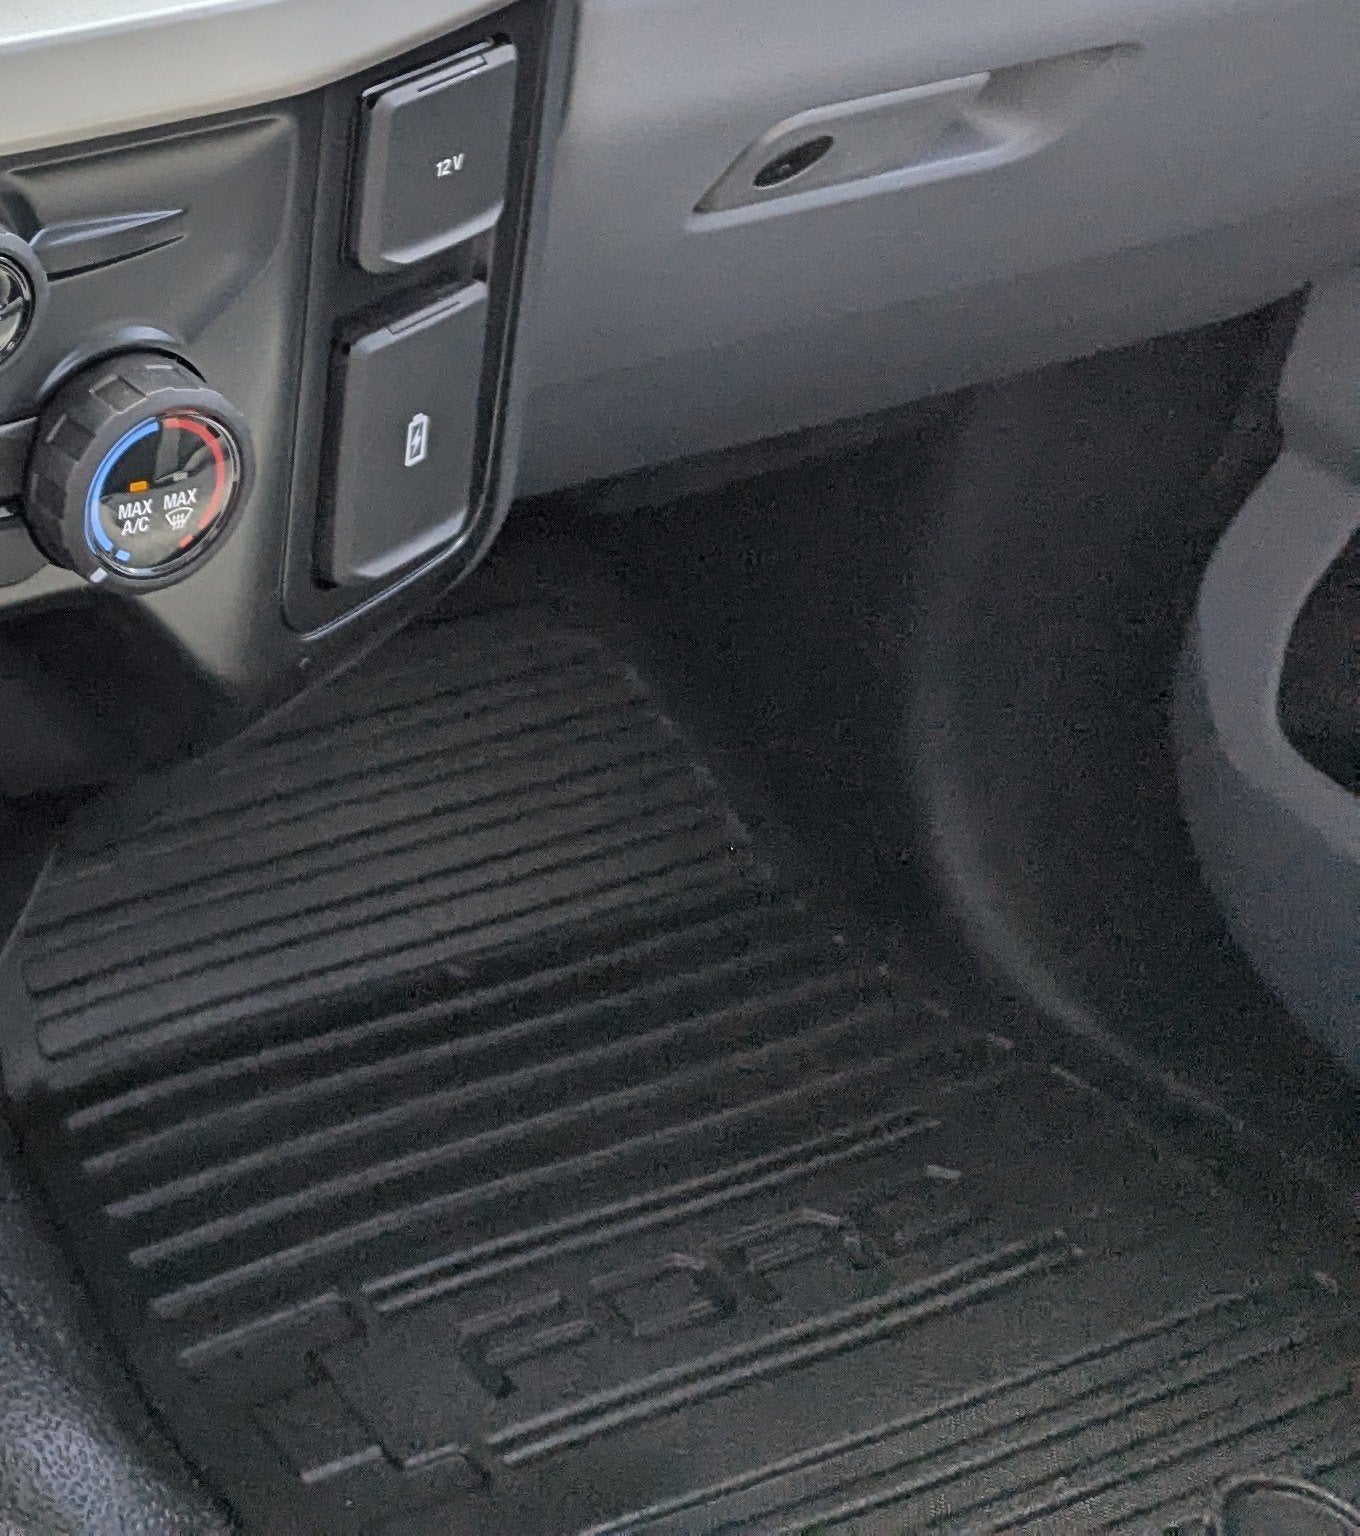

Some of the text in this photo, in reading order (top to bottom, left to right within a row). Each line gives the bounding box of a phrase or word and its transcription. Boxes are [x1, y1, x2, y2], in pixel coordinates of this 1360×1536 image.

[117, 498, 153, 520] MAX
[163, 488, 198, 510] MAX
[121, 516, 150, 536] A/C
